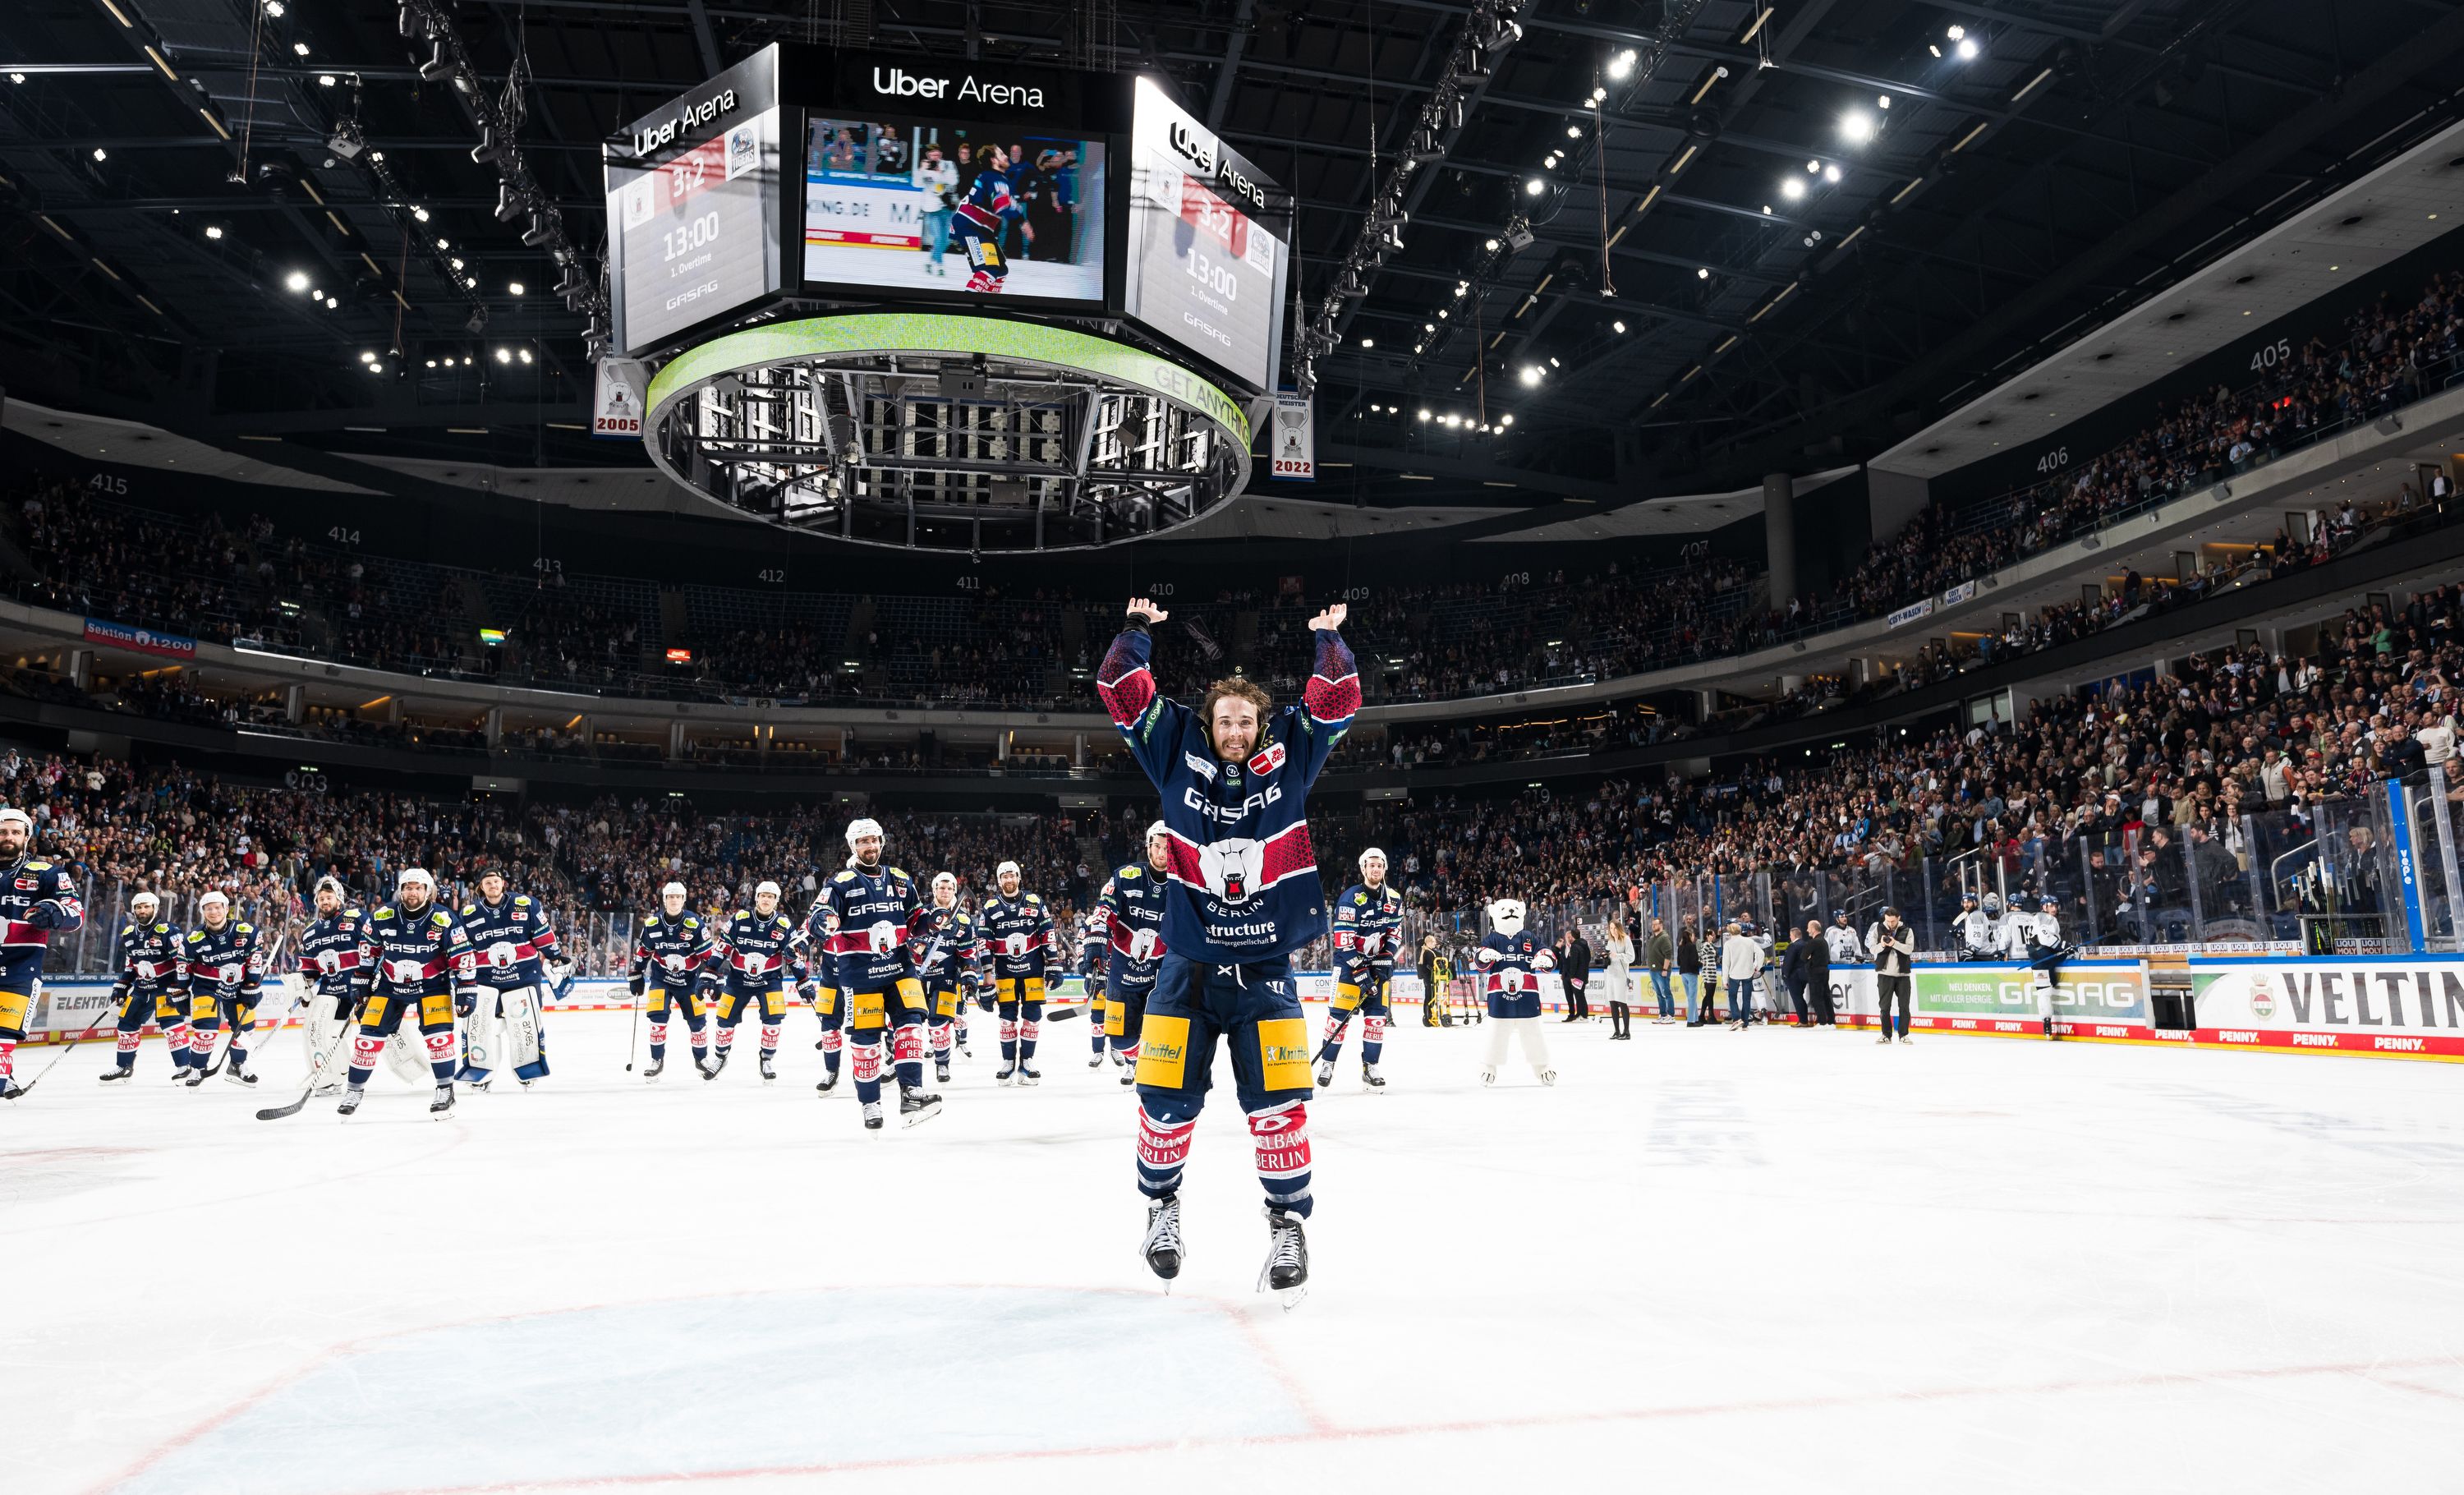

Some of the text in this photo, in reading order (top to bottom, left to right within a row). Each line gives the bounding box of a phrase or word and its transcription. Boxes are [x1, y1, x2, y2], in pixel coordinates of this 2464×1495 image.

[873, 67, 1044, 108] Uber Arena
[635, 89, 735, 157] Uber Arena
[732, 147, 755, 175] TIGERS
[1170, 122, 1265, 209] Uber Arena
[673, 157, 705, 198] 3:2
[1202, 197, 1230, 240] 3:2
[664, 210, 719, 262] 13:00
[670, 252, 712, 278] 1. Overtime
[1186, 248, 1237, 301] 13:00
[666, 280, 719, 311] GASAG
[1191, 286, 1229, 315] 1. Overtime
[1184, 311, 1231, 347] GASAG
[2250, 338, 2292, 370] 405
[1154, 366, 1249, 446] GET ANYTHING
[597, 418, 639, 432] 2005
[1275, 460, 1311, 473] 2022
[2037, 447, 2069, 474] 406
[90, 473, 127, 494] 415
[329, 527, 361, 545] 414
[759, 569, 785, 582] 412
[957, 577, 981, 590] 411
[1150, 583, 1175, 596] 410
[1342, 586, 1370, 601] 409
[1947, 595, 1963, 606] WASCH
[88, 623, 193, 651] Sektion 1200
[1184, 781, 1282, 825] GASAG
[886, 885, 894, 896] A
[1018, 908, 1025, 917] A
[1207, 898, 1264, 918] BERLIN
[475, 927, 524, 941] GASAG
[1206, 921, 1276, 937] structure
[145, 940, 150, 949] C
[306, 933, 352, 951] GASAG
[2336, 939, 2356, 947] LIQUI
[2361, 939, 2382, 947] LIQUI
[2337, 946, 2357, 955] MOLY
[2362, 946, 2382, 955] MOLY
[492, 964, 518, 974] BERLIN
[868, 962, 902, 974] structure
[1128, 959, 1152, 972] BERLIN
[1123, 973, 1156, 983] structure
[1949, 982, 1993, 991] NEU DENKEN.
[1502, 993, 1523, 1002] BERLIN
[1930, 995, 1994, 1004] MIT VOLLER ENERGIE.
[862, 1006, 884, 1014] Knittel
[470, 1014, 479, 1042] arxes
[1911, 1018, 1934, 1027] PENNY.
[1952, 1019, 1977, 1029] PENNY.
[1995, 1021, 2023, 1032] PENNY.
[522, 1020, 534, 1046] arxes
[2096, 1026, 2129, 1037] PENNY.
[2219, 1031, 2259, 1043] PENNY.
[2293, 1033, 2338, 1046] PENNY.
[2374, 1037, 2426, 1051] PENNY.
[1144, 1042, 1183, 1060] Knittel
[1256, 1149, 1305, 1169] BERLIN
